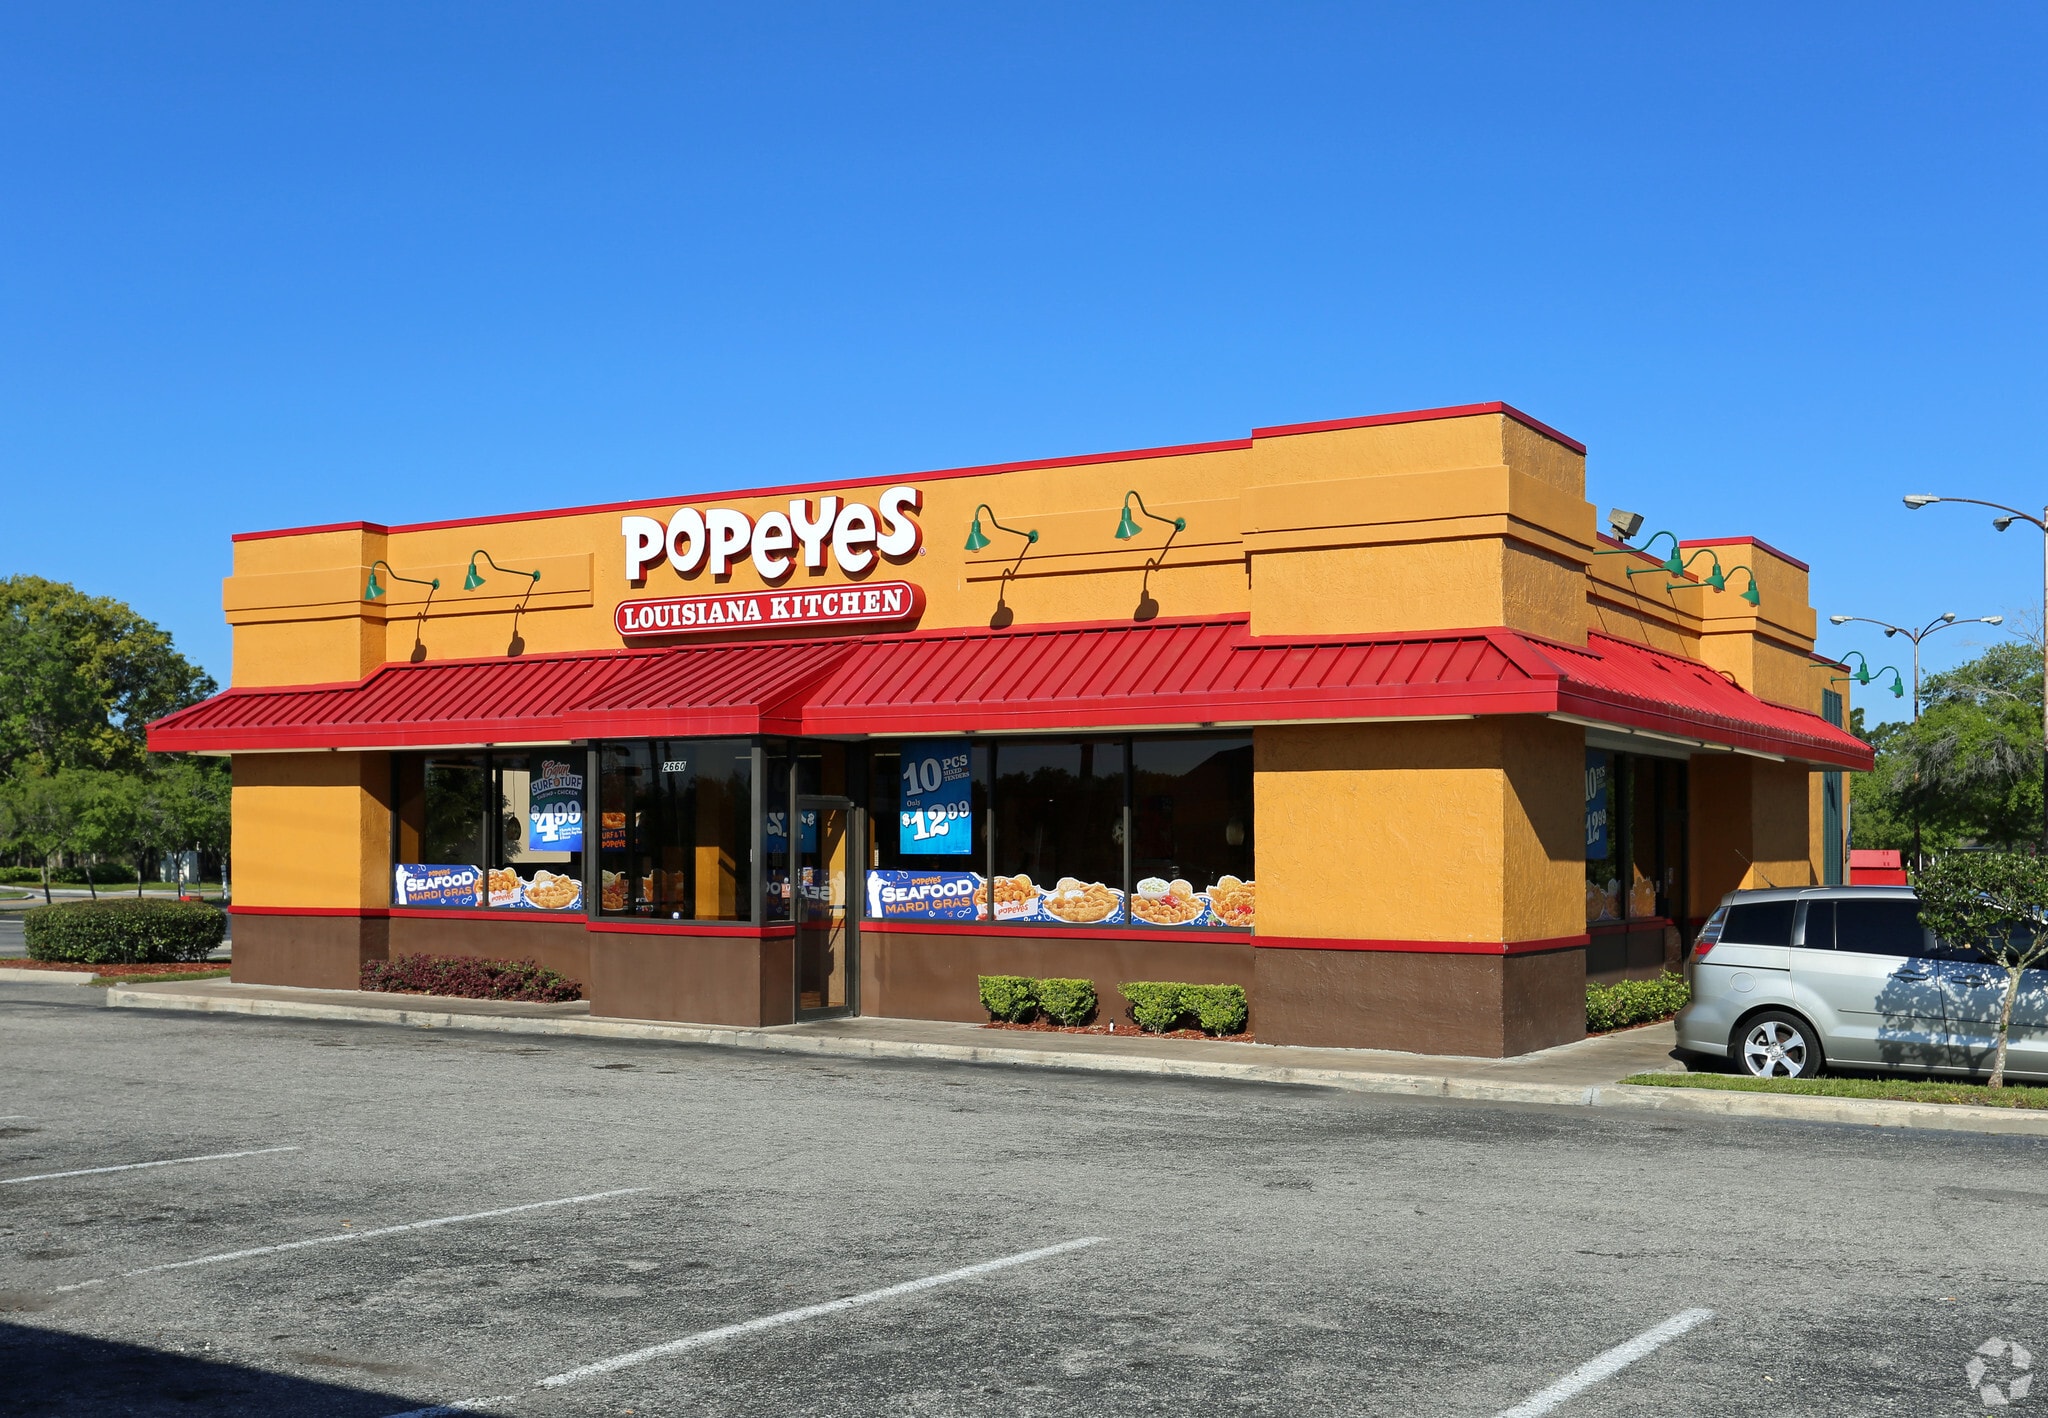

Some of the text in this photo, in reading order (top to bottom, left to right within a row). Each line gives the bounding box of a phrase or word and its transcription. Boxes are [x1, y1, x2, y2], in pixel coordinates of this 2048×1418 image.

[624, 588, 903, 630] LOUISIANA KITCHEN
[663, 762, 686, 772] 2660
[903, 754, 968, 796] 10 PCS
[944, 771, 970, 782] TENDERS
[532, 776, 582, 794] SURF TURF
[406, 871, 474, 892] SEAFOOD
[881, 879, 973, 902] SEAFOOD
[408, 886, 473, 901] MARDI GRAS
[885, 896, 971, 915] MARDI GRAS
